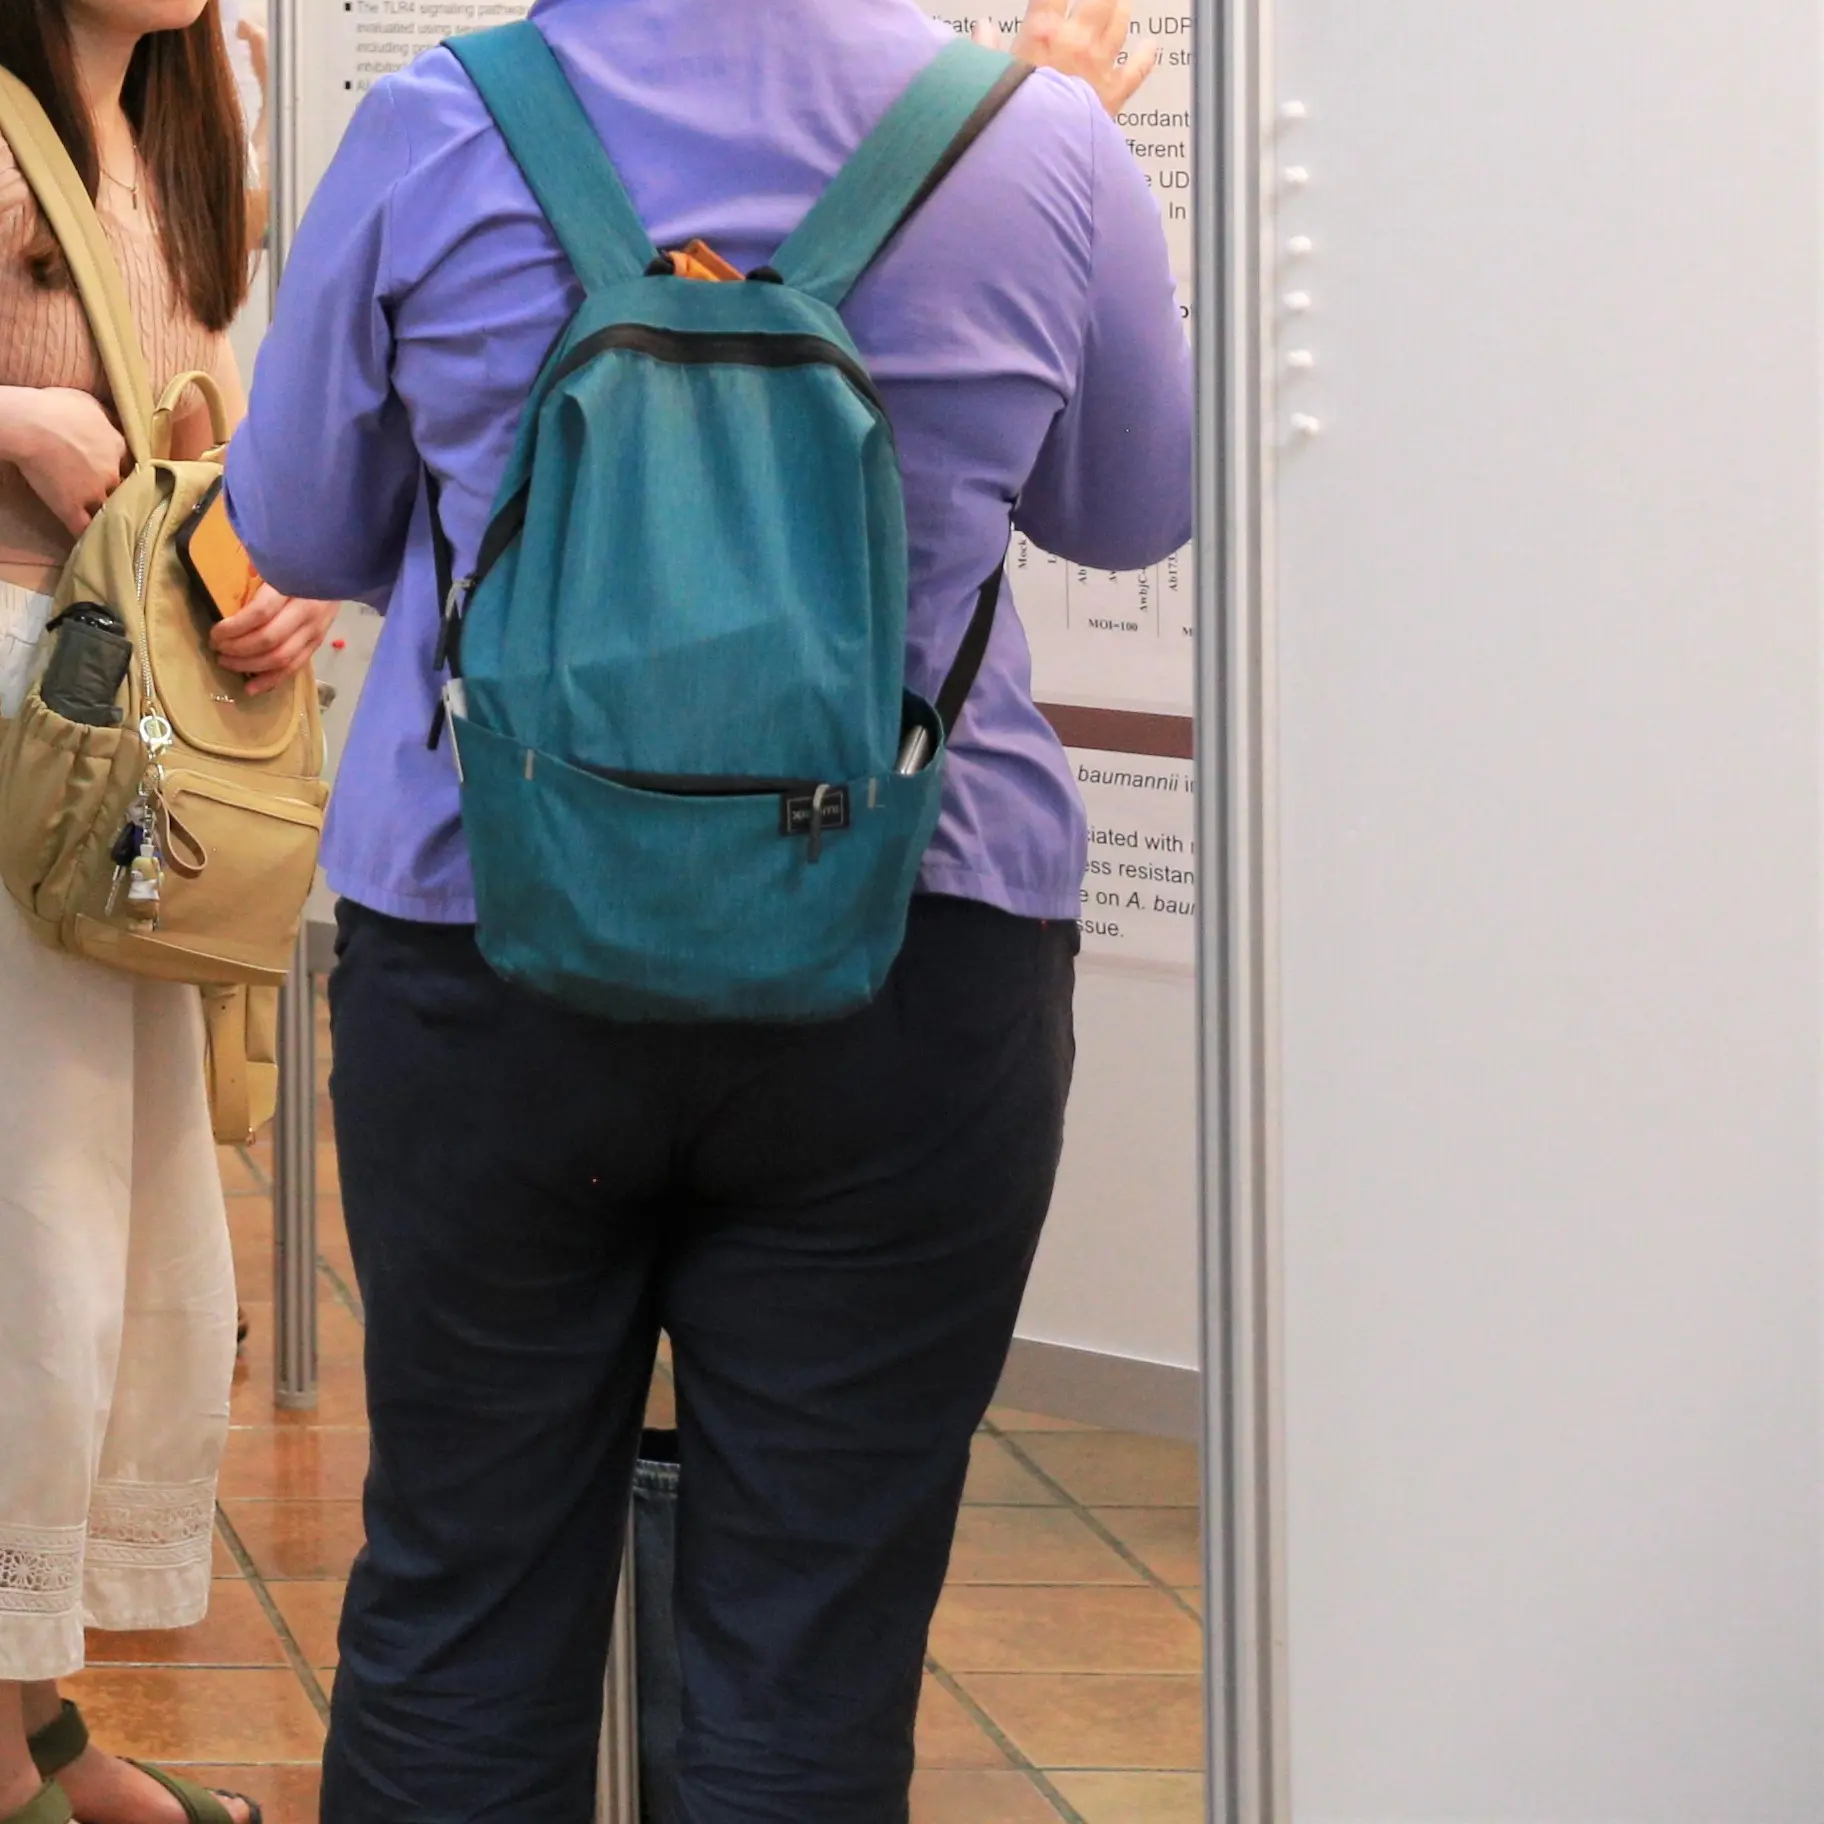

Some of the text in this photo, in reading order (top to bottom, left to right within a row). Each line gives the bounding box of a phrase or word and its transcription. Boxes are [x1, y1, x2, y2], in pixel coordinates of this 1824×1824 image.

[1078, 764, 1179, 792] baumannii
[1144, 833, 1184, 854] with
[1095, 891, 1146, 911] on A.
